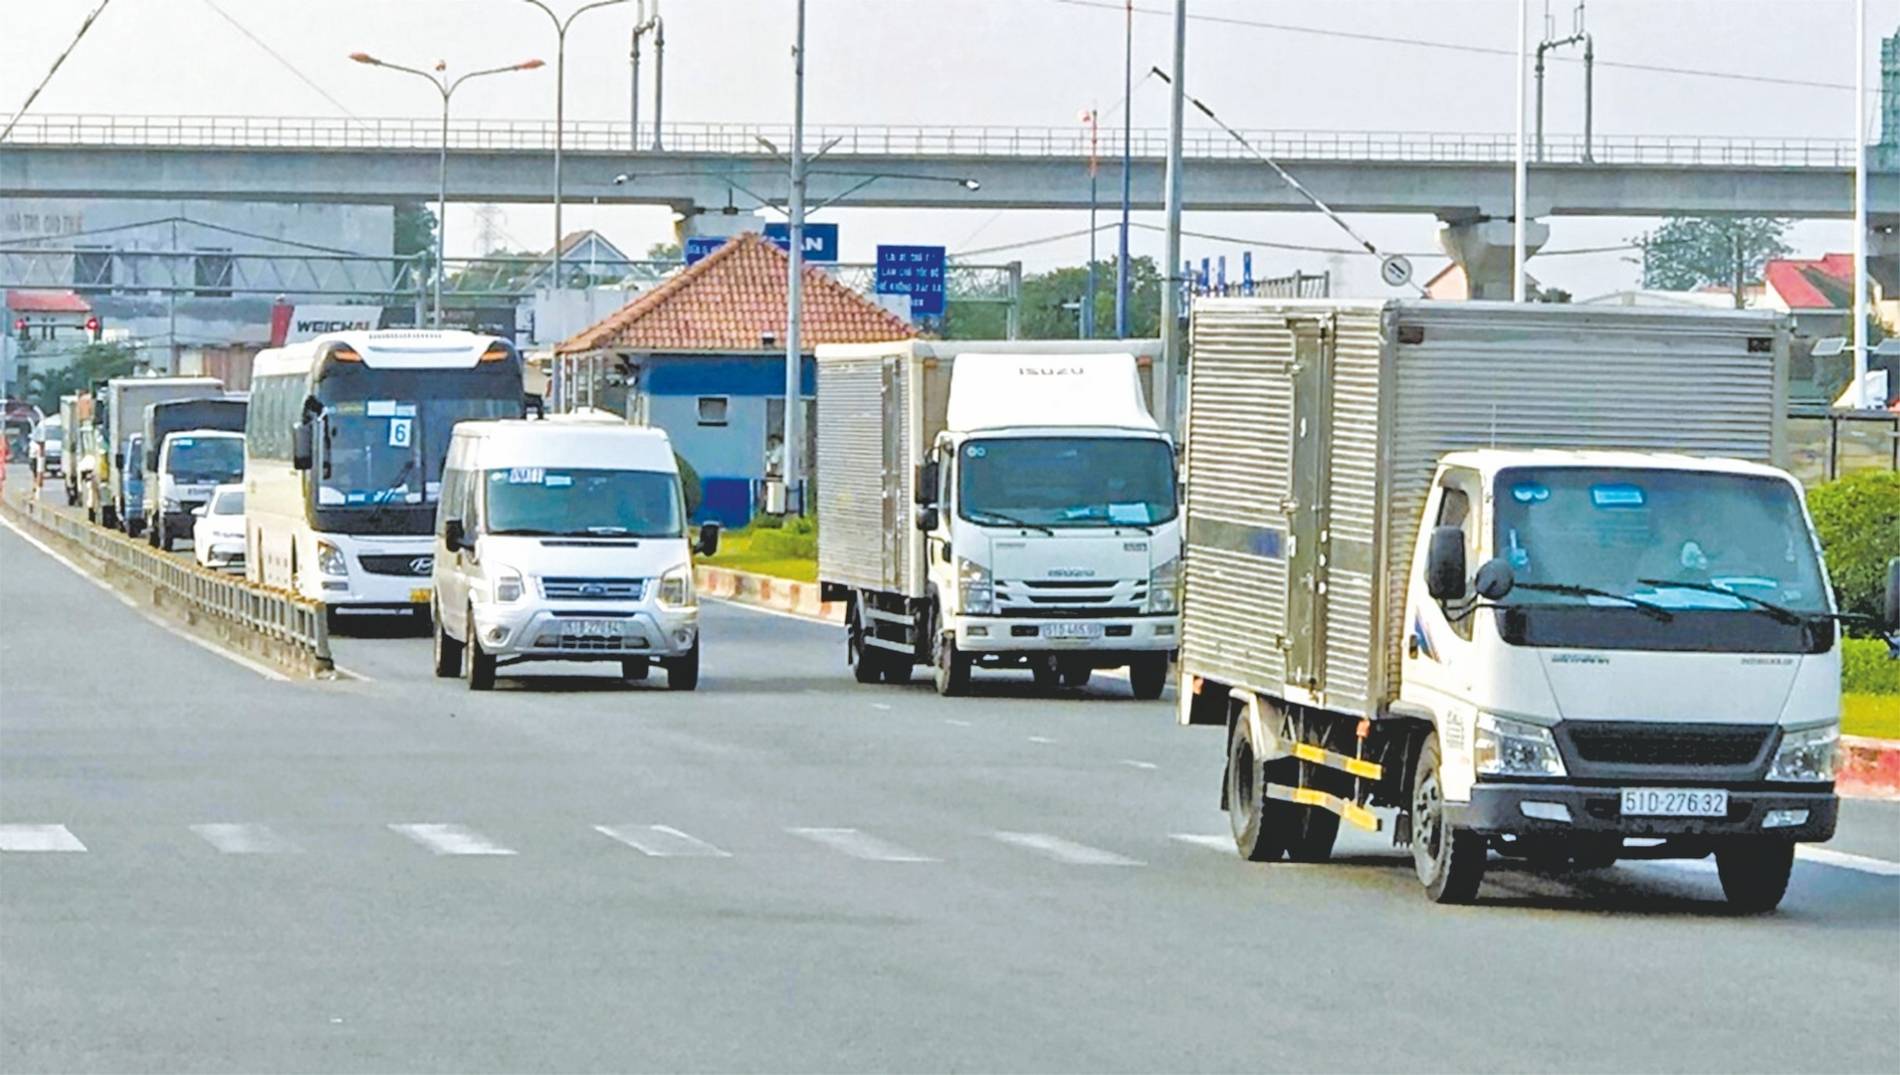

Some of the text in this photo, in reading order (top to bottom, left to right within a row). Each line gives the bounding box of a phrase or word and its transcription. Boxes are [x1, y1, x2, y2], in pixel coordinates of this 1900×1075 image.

[297, 320, 369, 332] WEICHAI
[1019, 367, 1084, 376] ISUZU
[395, 423, 407, 442] 6
